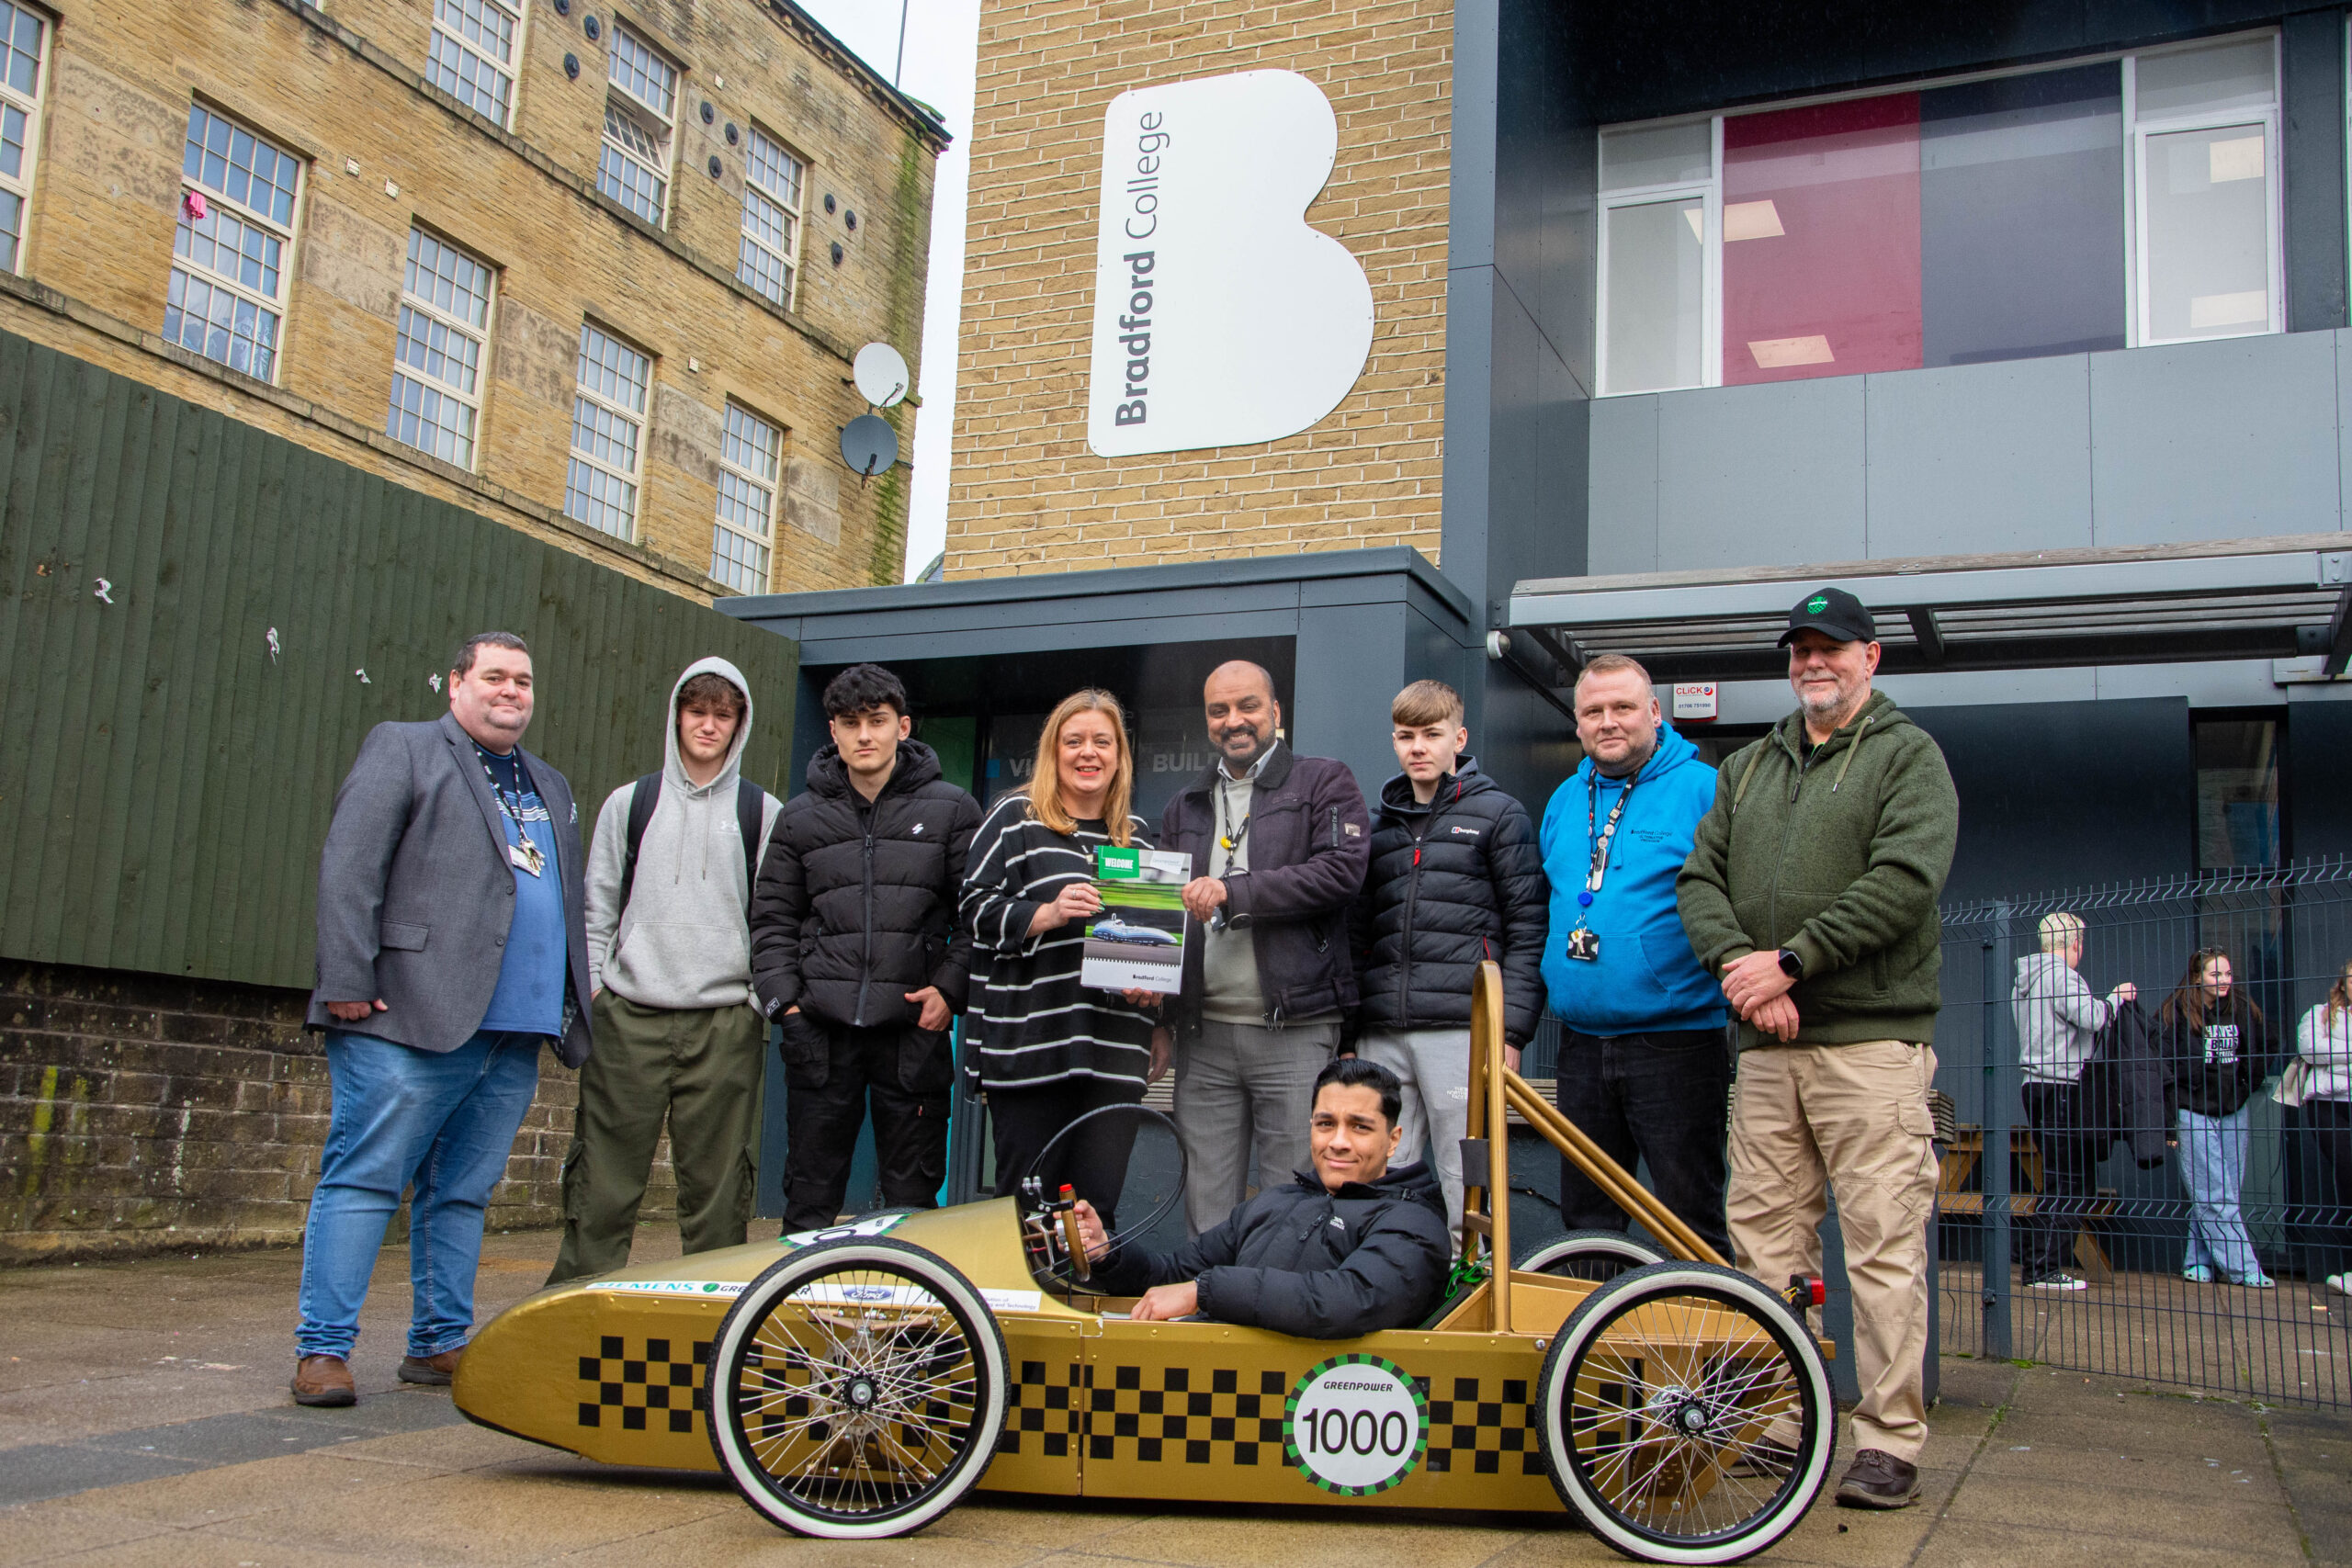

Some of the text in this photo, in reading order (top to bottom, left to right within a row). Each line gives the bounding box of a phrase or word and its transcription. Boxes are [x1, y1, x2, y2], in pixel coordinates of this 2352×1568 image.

[1115, 111, 1170, 426] Bradford College
[1104, 857, 1134, 870] WELCOME
[851, 1288, 884, 1300] Ford
[1324, 1381, 1394, 1392] GREENPOWER
[1302, 1408, 1408, 1457] 1000
